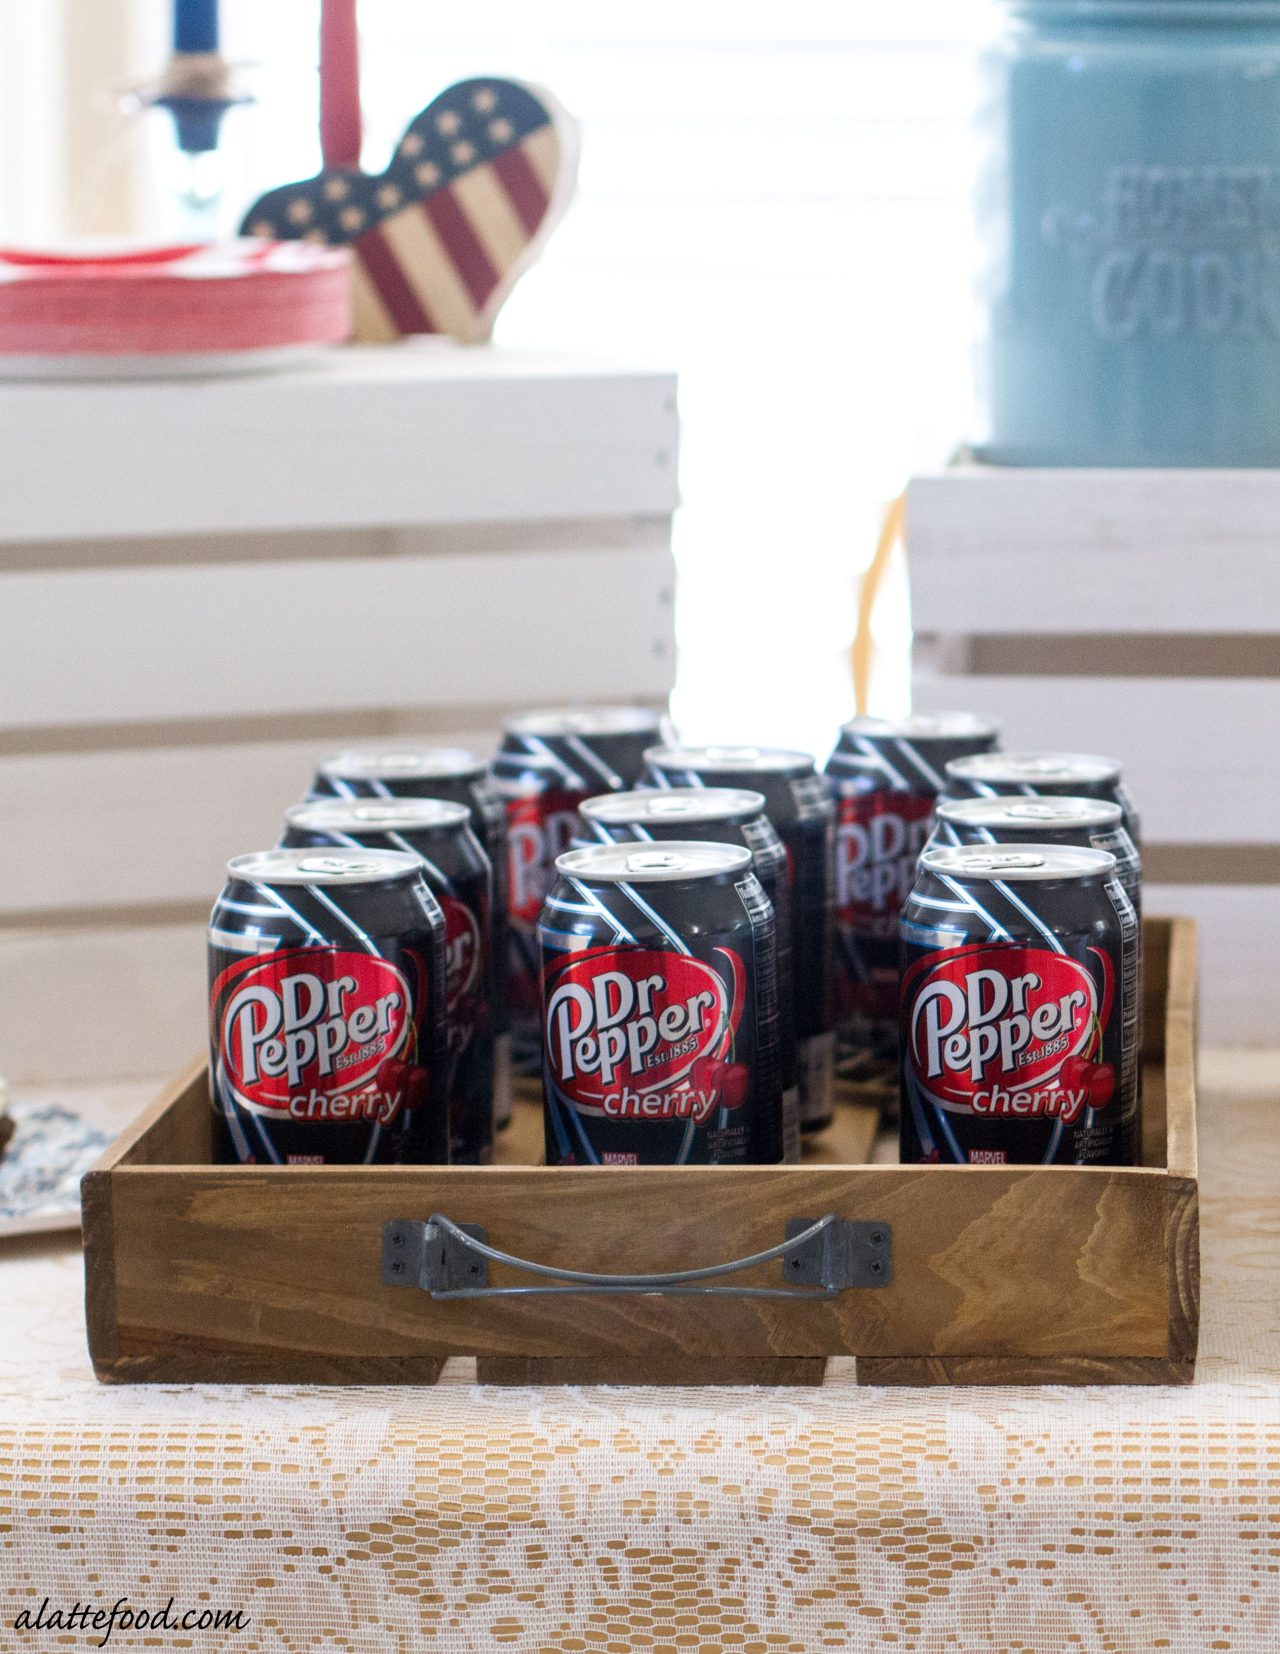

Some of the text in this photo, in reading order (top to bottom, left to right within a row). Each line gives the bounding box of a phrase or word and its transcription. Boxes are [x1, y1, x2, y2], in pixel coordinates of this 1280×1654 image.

[280, 972, 357, 1032] Dr
[591, 971, 667, 1031] Dr
[965, 968, 1042, 1029] Dr
[225, 985, 401, 1087] Pepper
[547, 983, 715, 1086] Pepper
[911, 980, 1086, 1083] Pepper
[289, 1088, 400, 1122] cherry
[603, 1086, 717, 1121] cherry
[972, 1084, 1085, 1120] cherry
